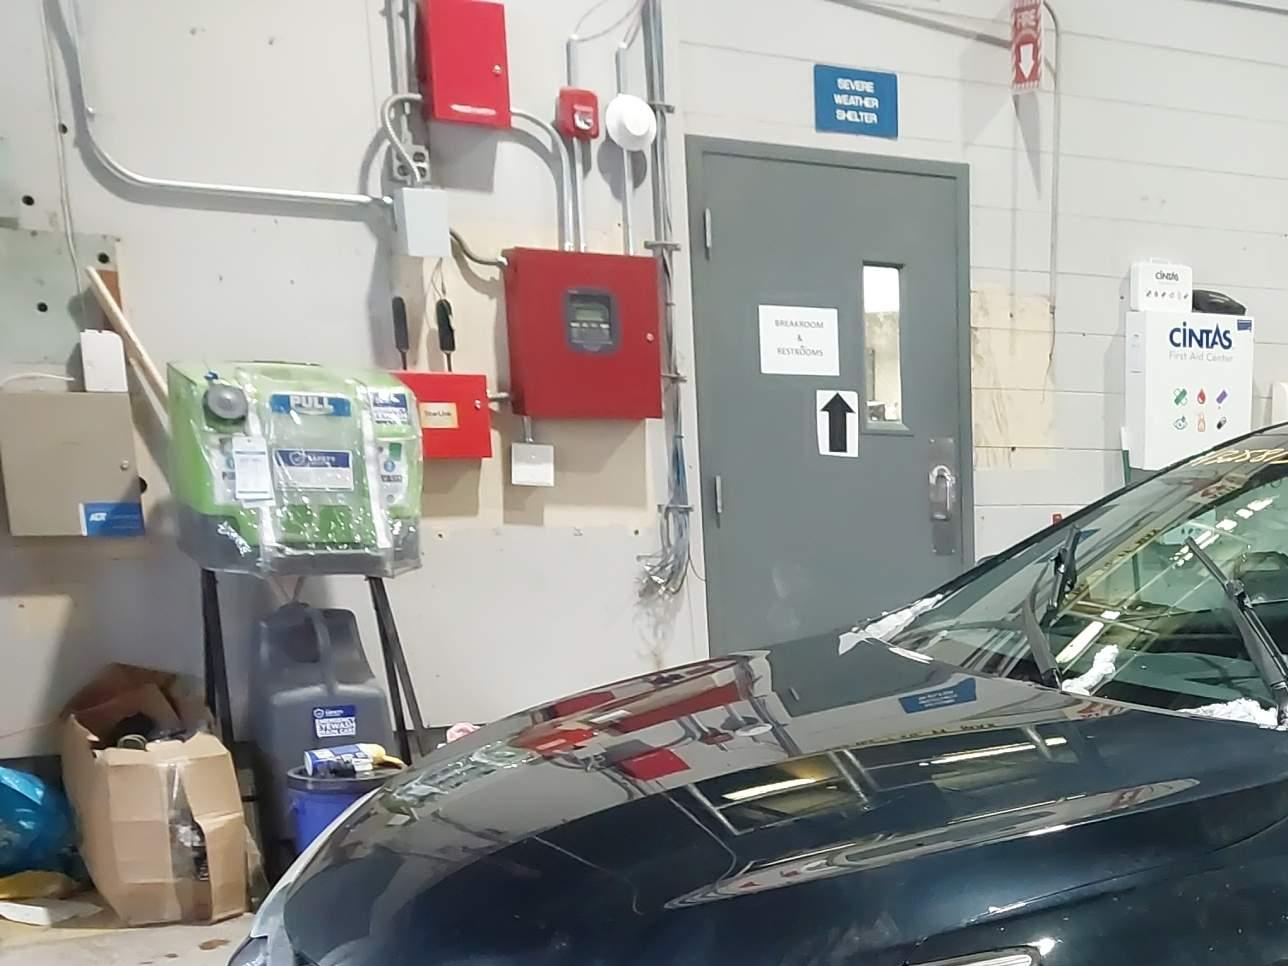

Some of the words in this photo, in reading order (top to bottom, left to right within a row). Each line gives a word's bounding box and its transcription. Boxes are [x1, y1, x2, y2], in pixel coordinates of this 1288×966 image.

[1016, 9, 1037, 30] FIRE
[837, 78, 874, 93] SEVERE
[833, 93, 879, 108] WEATHER
[835, 109, 878, 124] SHELTER
[775, 319, 824, 329] BREAKROOM
[777, 347, 823, 357] RESTROOMS
[1169, 351, 1188, 361] First
[1191, 352, 1204, 361] Aid
[1206, 353, 1233, 362] Center
